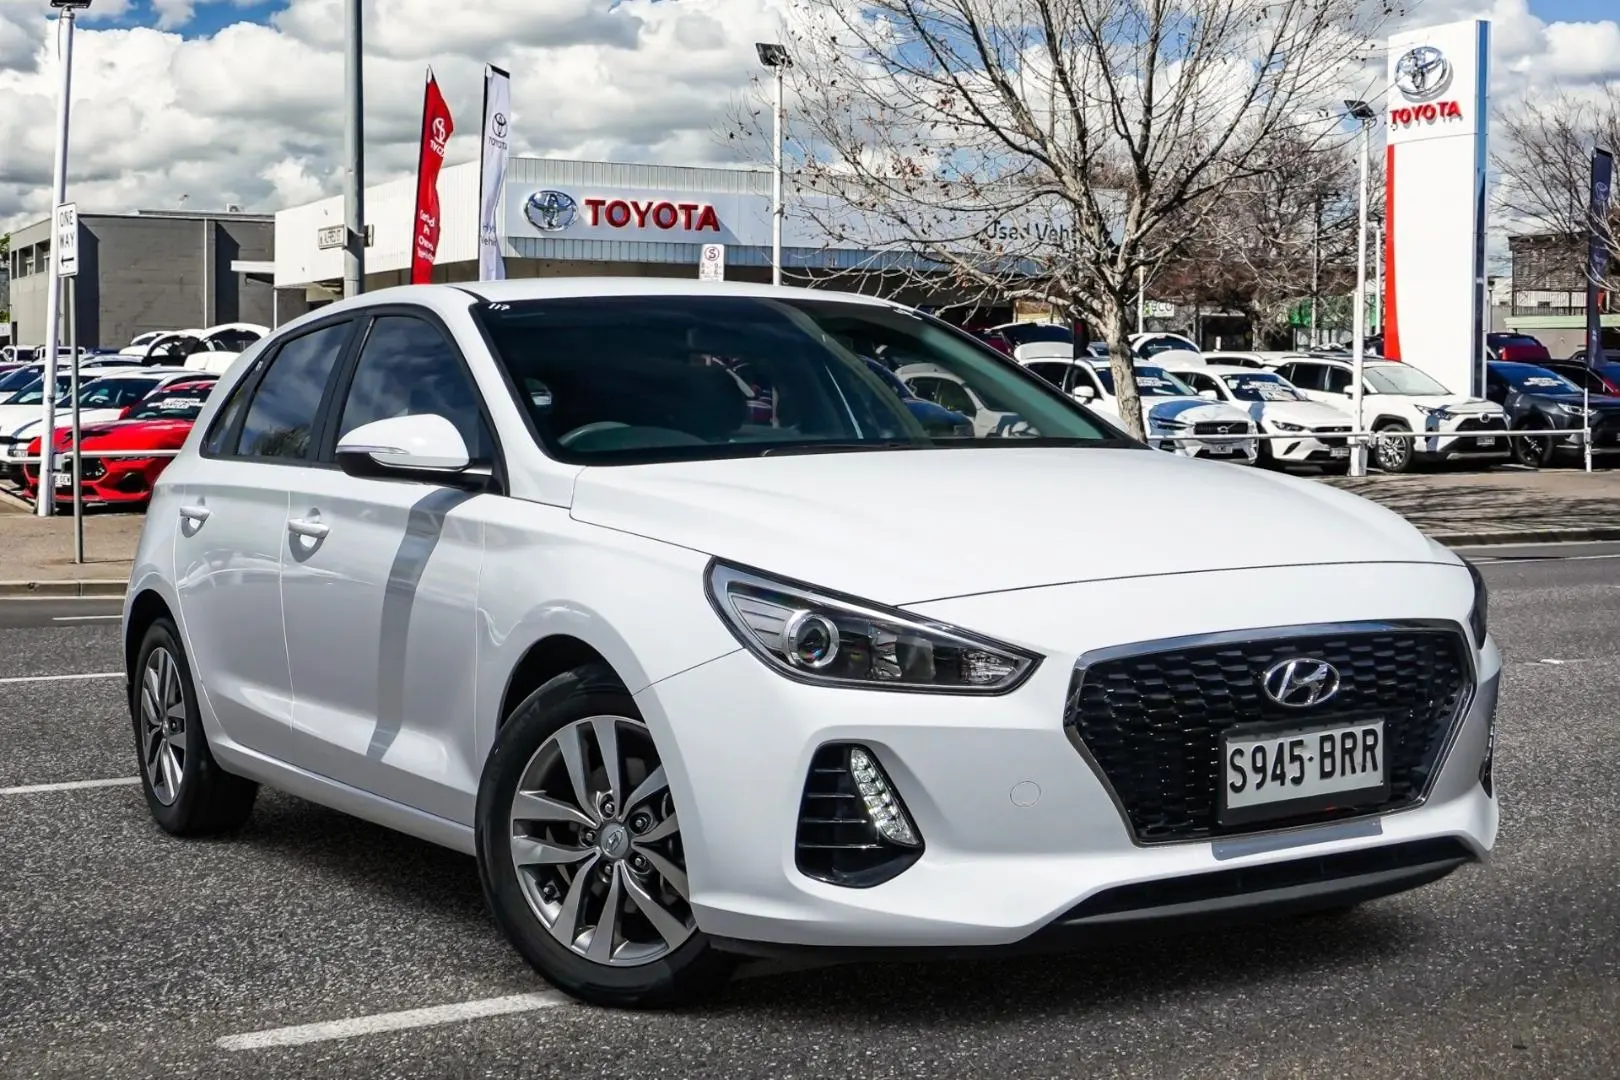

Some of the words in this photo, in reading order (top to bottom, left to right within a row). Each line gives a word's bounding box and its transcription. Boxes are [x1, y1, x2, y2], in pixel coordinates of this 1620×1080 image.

[1390, 101, 1462, 124] TOYOTA
[60, 209, 74, 228] ONE
[585, 199, 721, 232] TOYOTA
[59, 231, 75, 249] WAY
